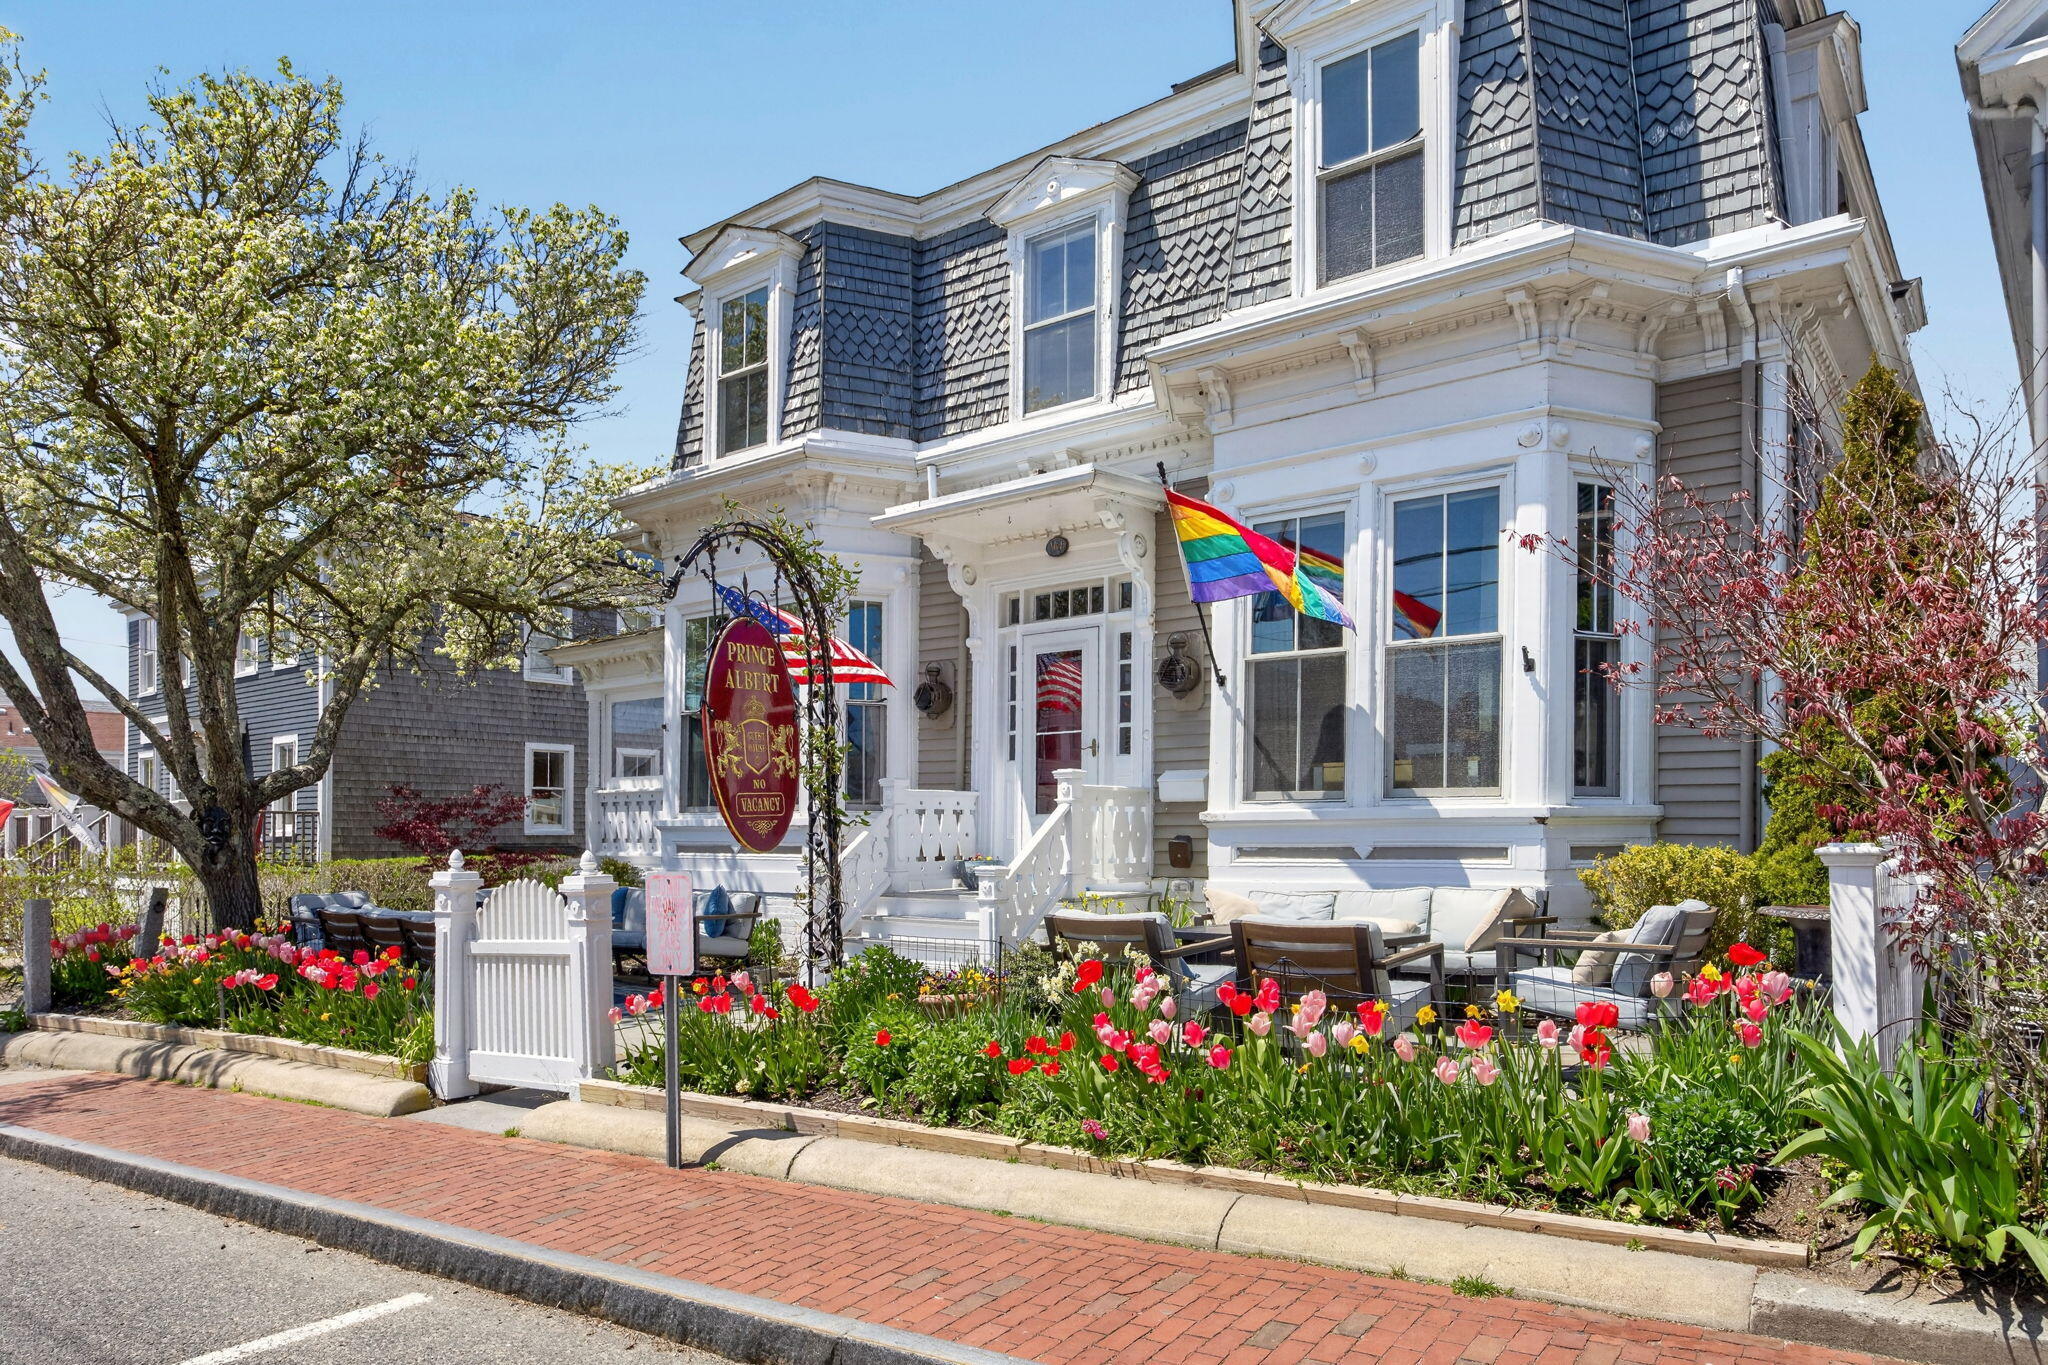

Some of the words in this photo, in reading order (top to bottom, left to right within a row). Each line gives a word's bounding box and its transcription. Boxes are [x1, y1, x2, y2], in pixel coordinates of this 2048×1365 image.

[727, 641, 776, 667] PRINCE
[725, 668, 780, 694] ALBERT
[752, 779, 766, 789] NO
[740, 797, 780, 812] VACANCY
